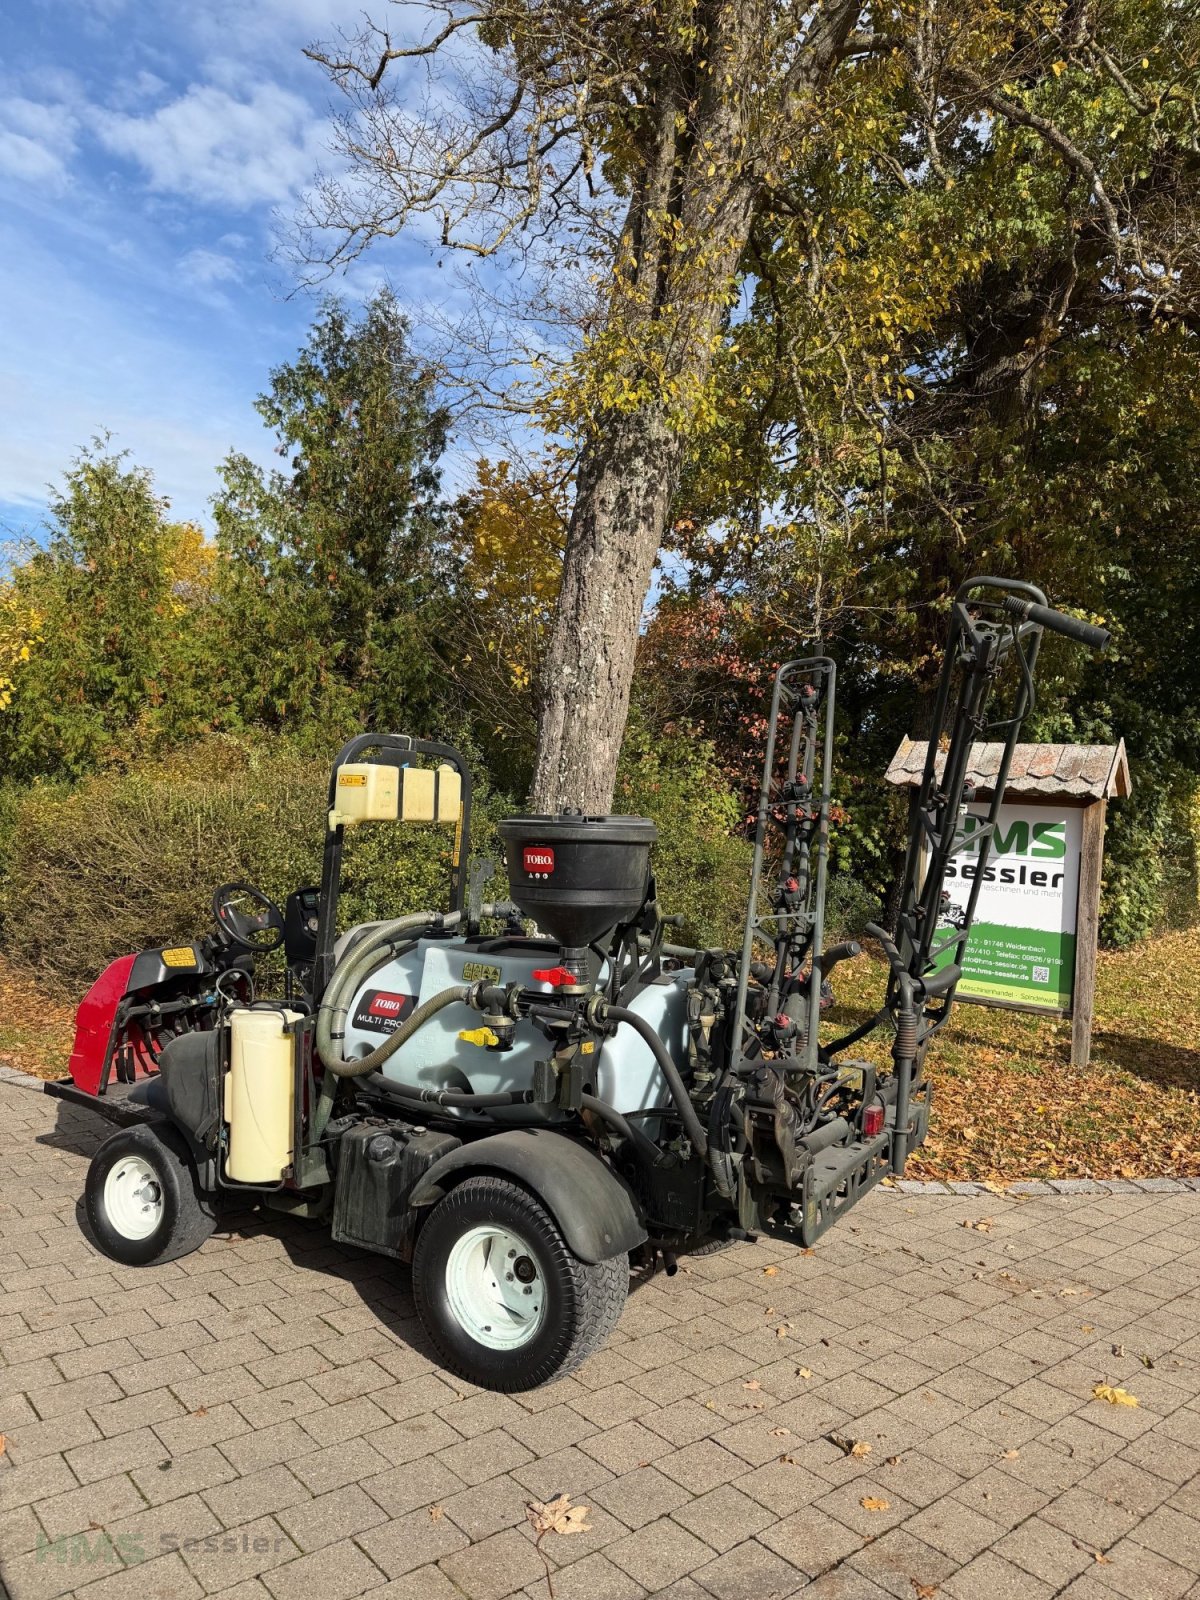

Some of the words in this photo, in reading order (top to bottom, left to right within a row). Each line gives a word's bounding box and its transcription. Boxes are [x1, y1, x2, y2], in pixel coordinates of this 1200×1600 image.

[944, 858, 1064, 888] Sessler
[1023, 888, 1039, 896] und
[1041, 889, 1063, 899] mehr
[1005, 942, 1046, 954] Weidenbach
[357, 1014, 382, 1025] MULTI
[384, 1018, 404, 1028] PRO
